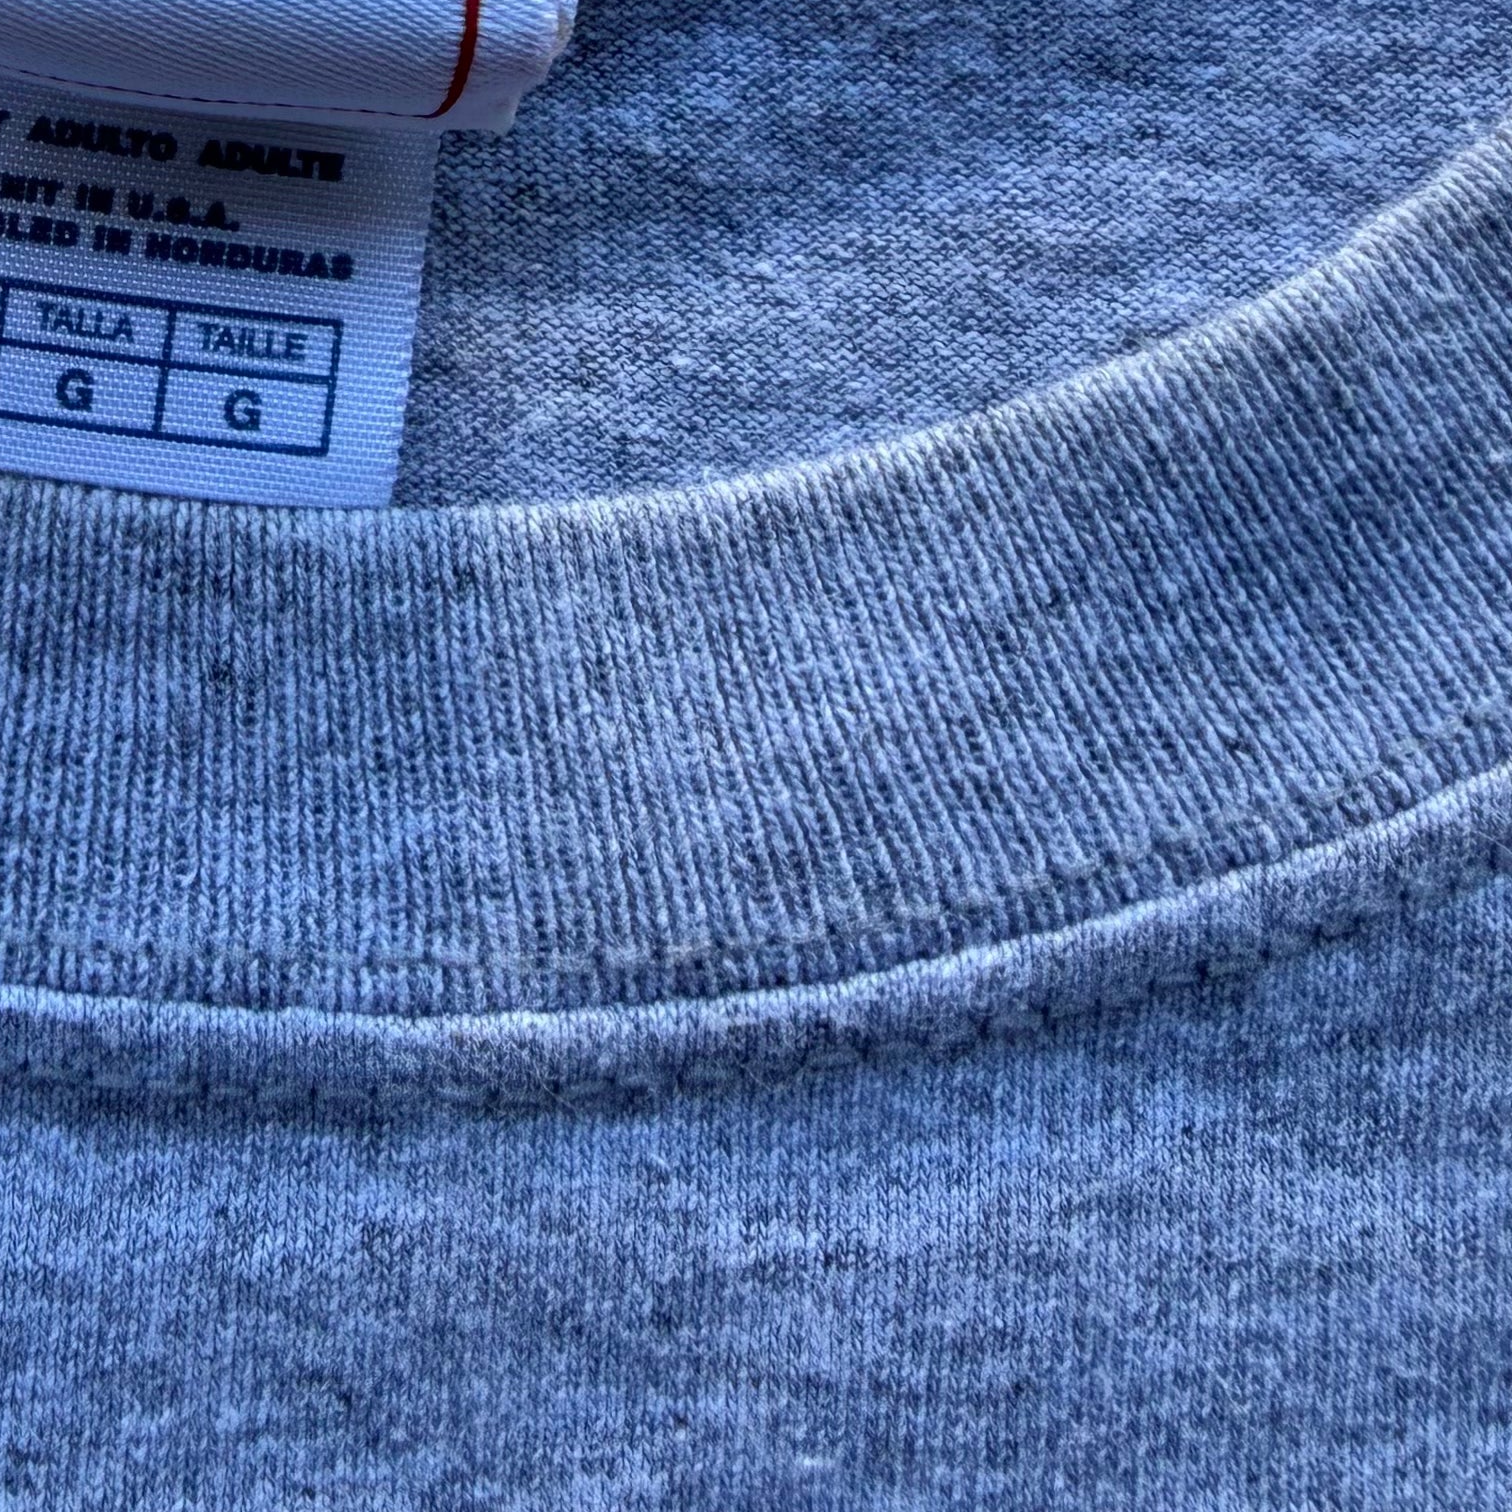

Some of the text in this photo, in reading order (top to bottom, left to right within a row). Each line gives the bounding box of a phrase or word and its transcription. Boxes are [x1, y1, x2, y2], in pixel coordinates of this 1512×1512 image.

[27, 115, 177, 161] ADULTO
[198, 139, 346, 182] ADULTE
[75, 183, 114, 215] IN
[127, 190, 240, 232] U.S.A.
[93, 223, 132, 256] IN
[144, 231, 356, 280] HONDURAS
[35, 302, 135, 341] TALLA
[198, 322, 306, 360] TAILLE
[56, 368, 94, 411] G
[223, 389, 261, 432] G
